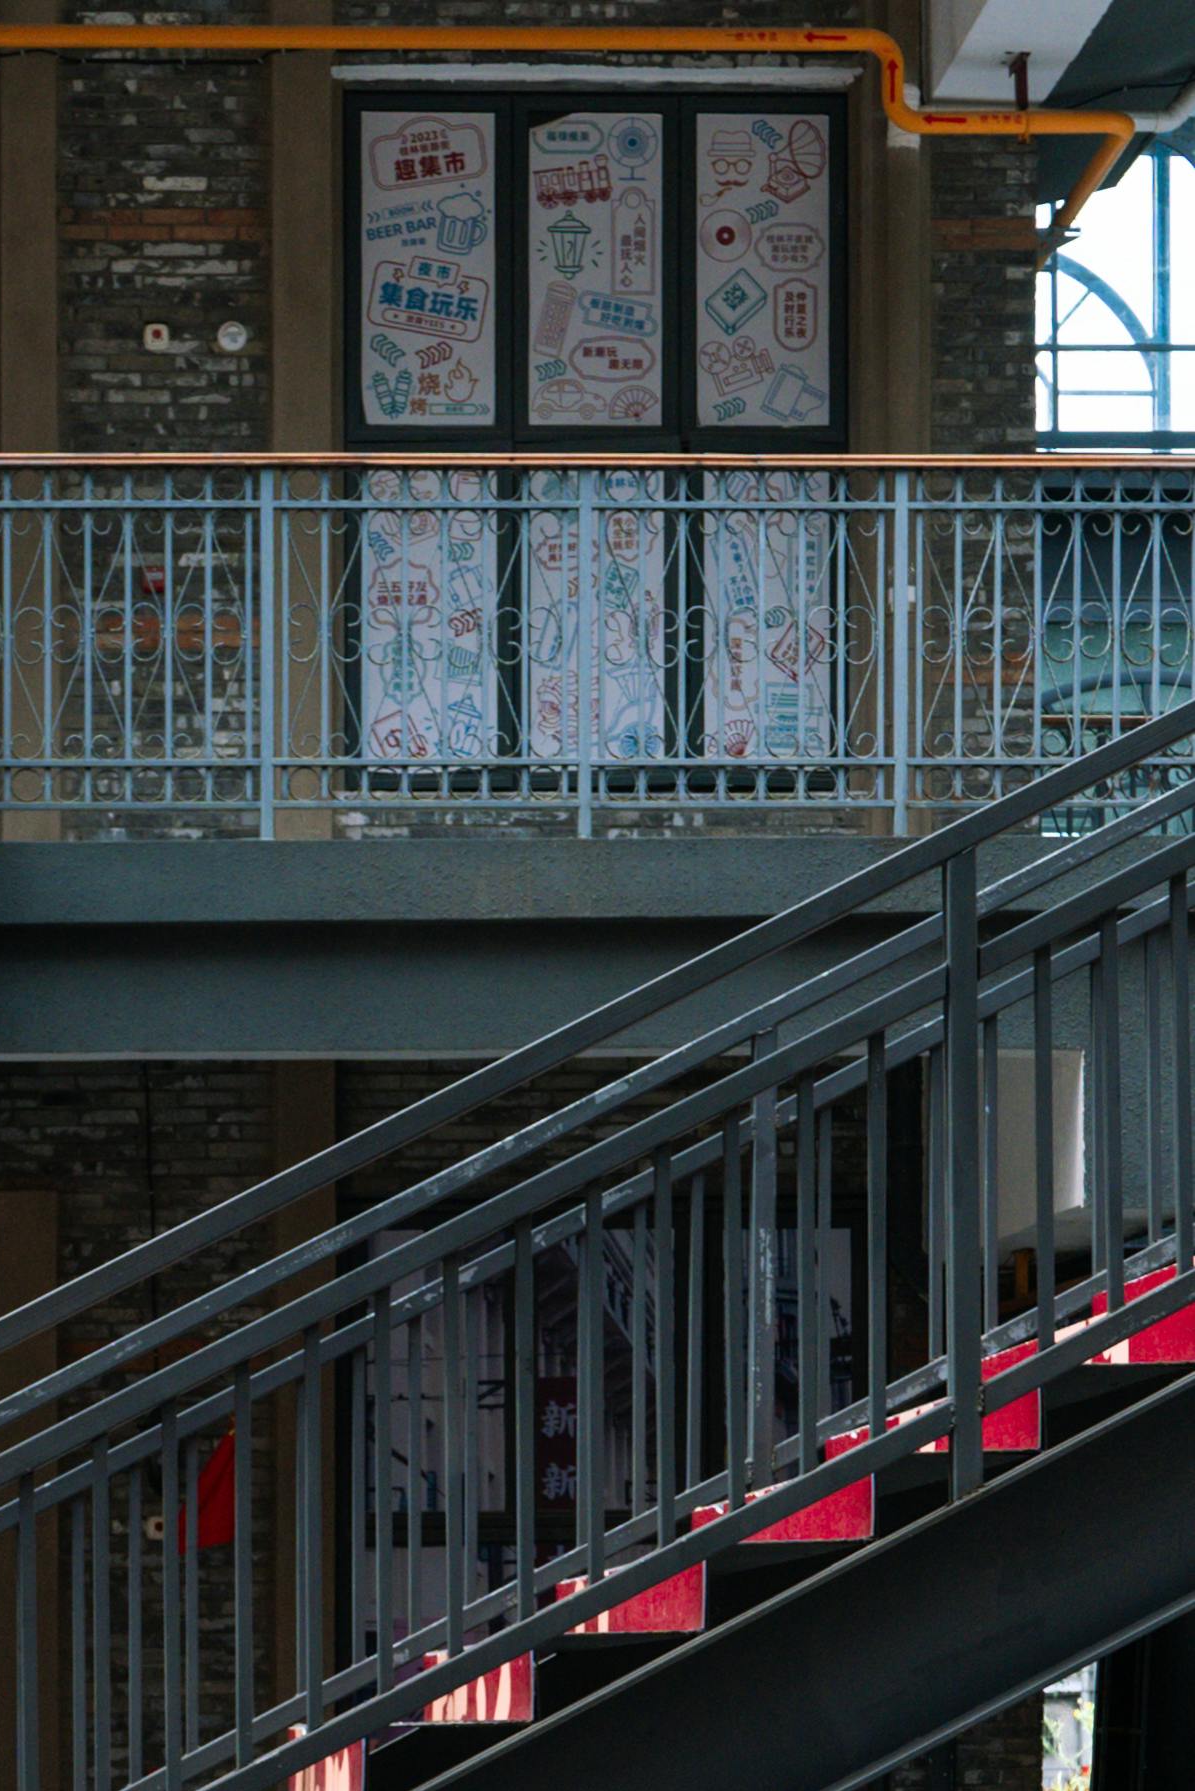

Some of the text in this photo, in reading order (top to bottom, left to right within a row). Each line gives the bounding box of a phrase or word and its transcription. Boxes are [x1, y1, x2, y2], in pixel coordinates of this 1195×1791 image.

[411, 130, 438, 143] 2023
[365, 217, 438, 241] BEER BAR
[379, 280, 481, 323] 集食玩乐
